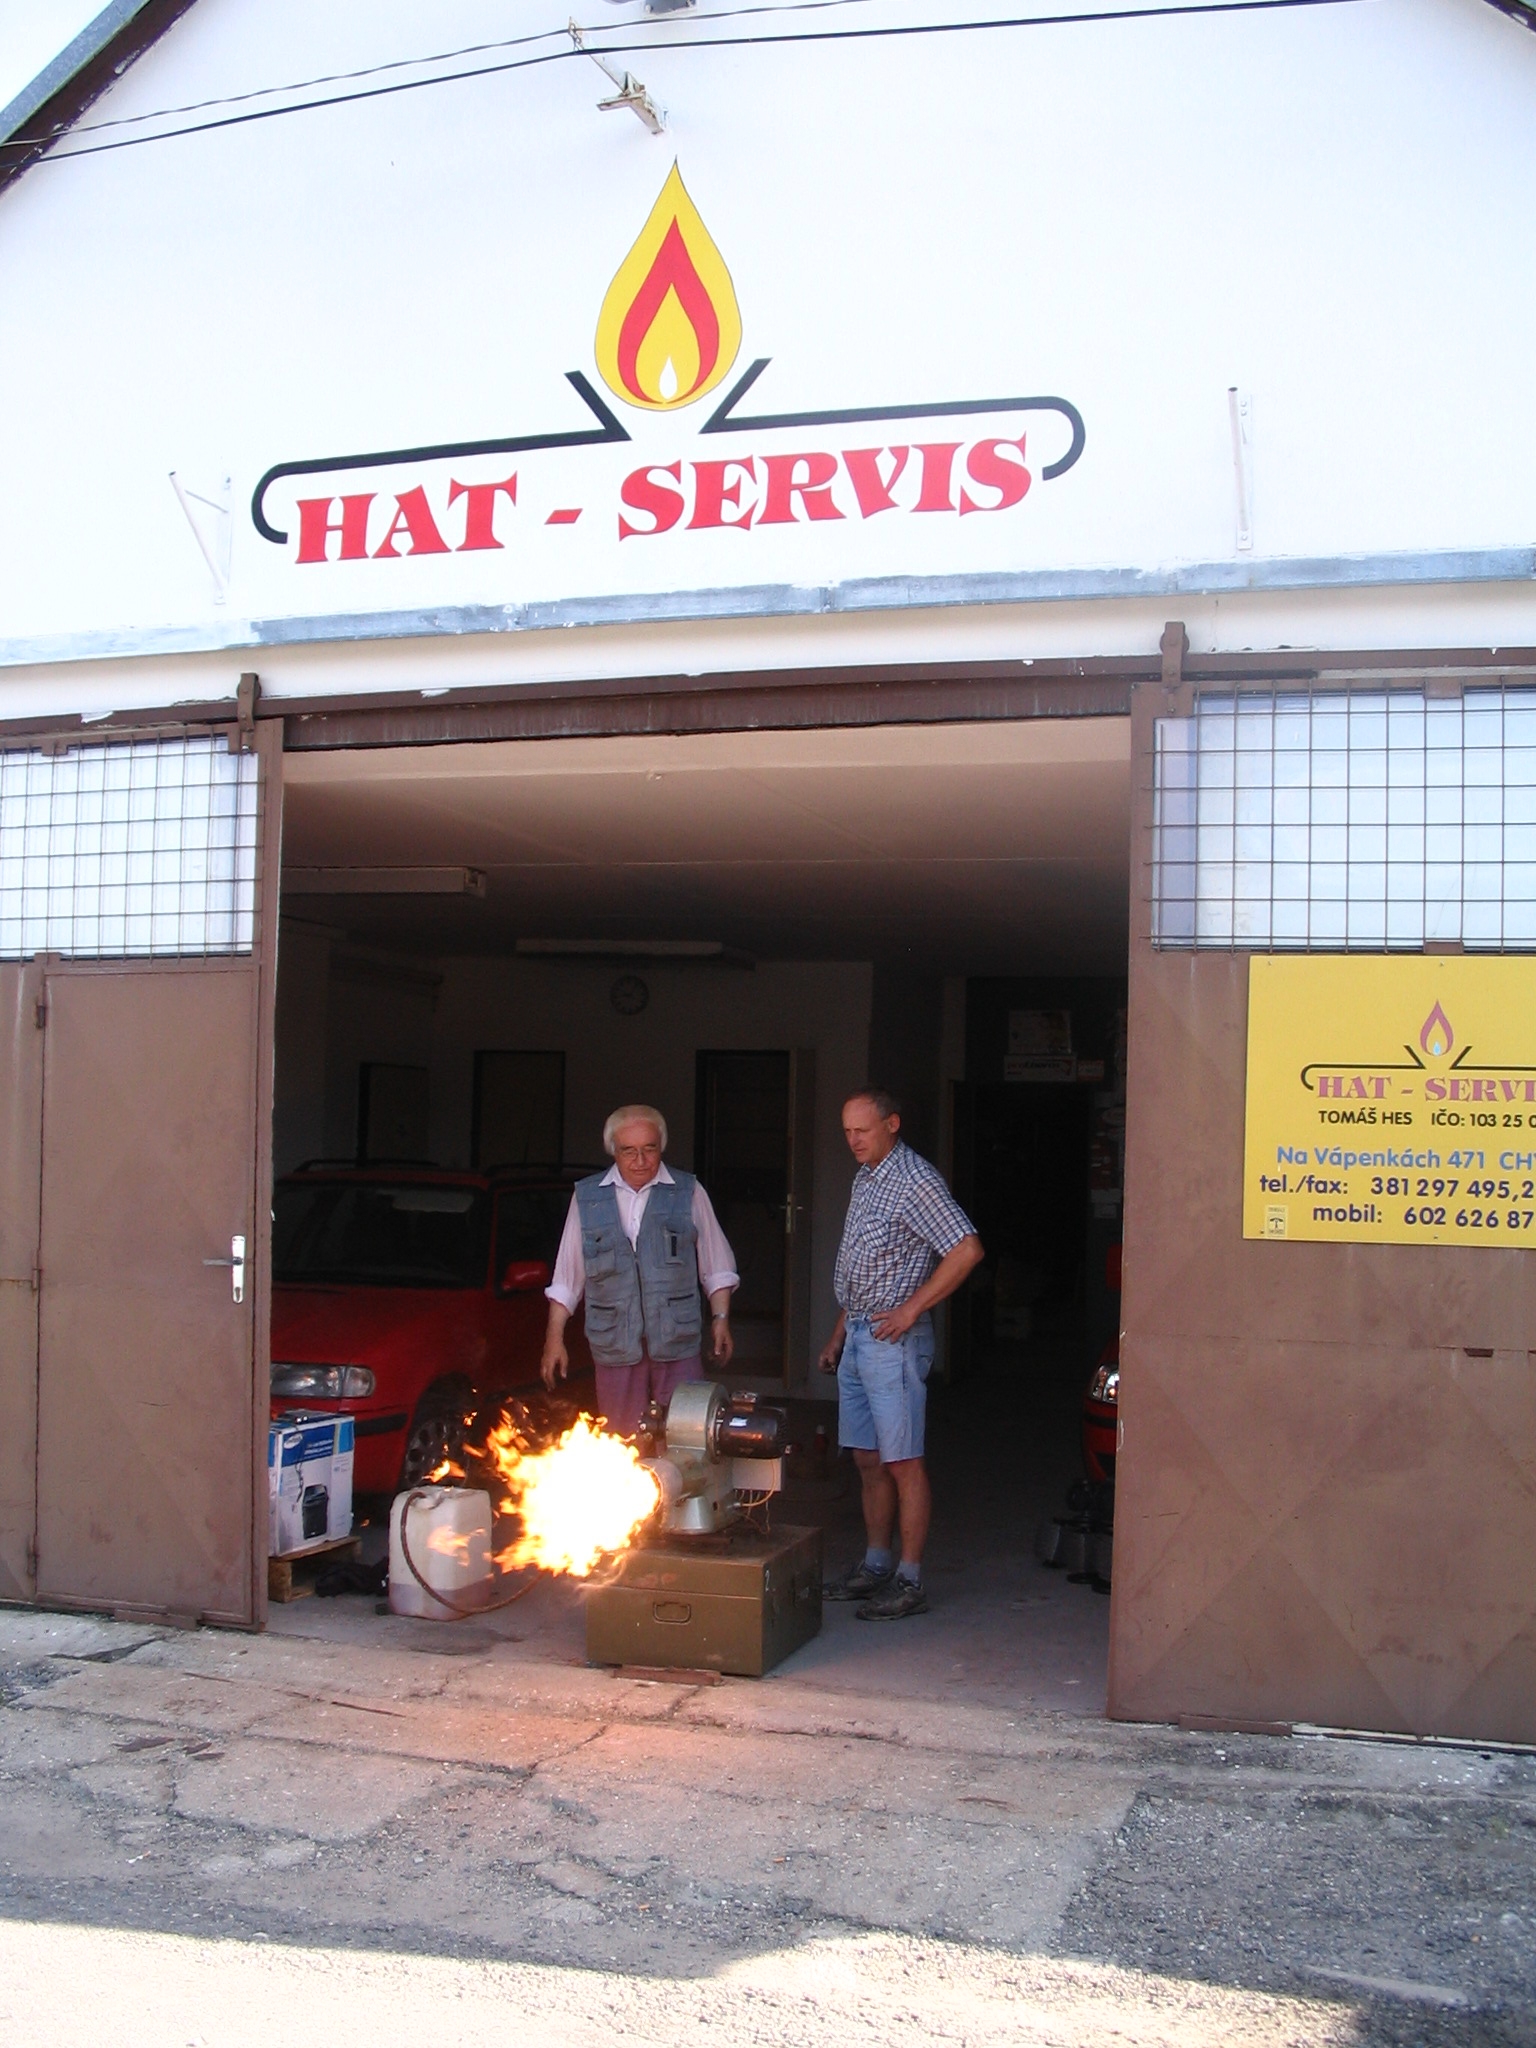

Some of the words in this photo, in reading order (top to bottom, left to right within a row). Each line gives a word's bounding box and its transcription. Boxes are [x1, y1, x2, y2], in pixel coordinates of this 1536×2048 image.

[295, 471, 518, 565] HAT
[544, 508, 583, 525] -
[618, 432, 1033, 542] SERVIS
[1317, 1075, 1392, 1099] HAT
[1319, 1107, 1377, 1126] TOMÁŠ
[1382, 1112, 1413, 1126] HES
[1431, 1109, 1466, 1127] IČO:
[1470, 1113, 1497, 1128] 103
[1502, 1114, 1523, 1128] 25
[1277, 1146, 1308, 1166] Na
[1314, 1147, 1440, 1170] Vápenkách
[1447, 1151, 1486, 1169] 471
[1500, 1151, 1536, 1171] CH
[1259, 1174, 1349, 1195] tel./fax:
[1370, 1176, 1410, 1197] 381
[1416, 1178, 1459, 1198] 297
[1312, 1204, 1383, 1224] mobil:
[1403, 1206, 1446, 1226] 602
[1455, 1209, 1499, 1229] 626
[1507, 1210, 1535, 1230] 87
